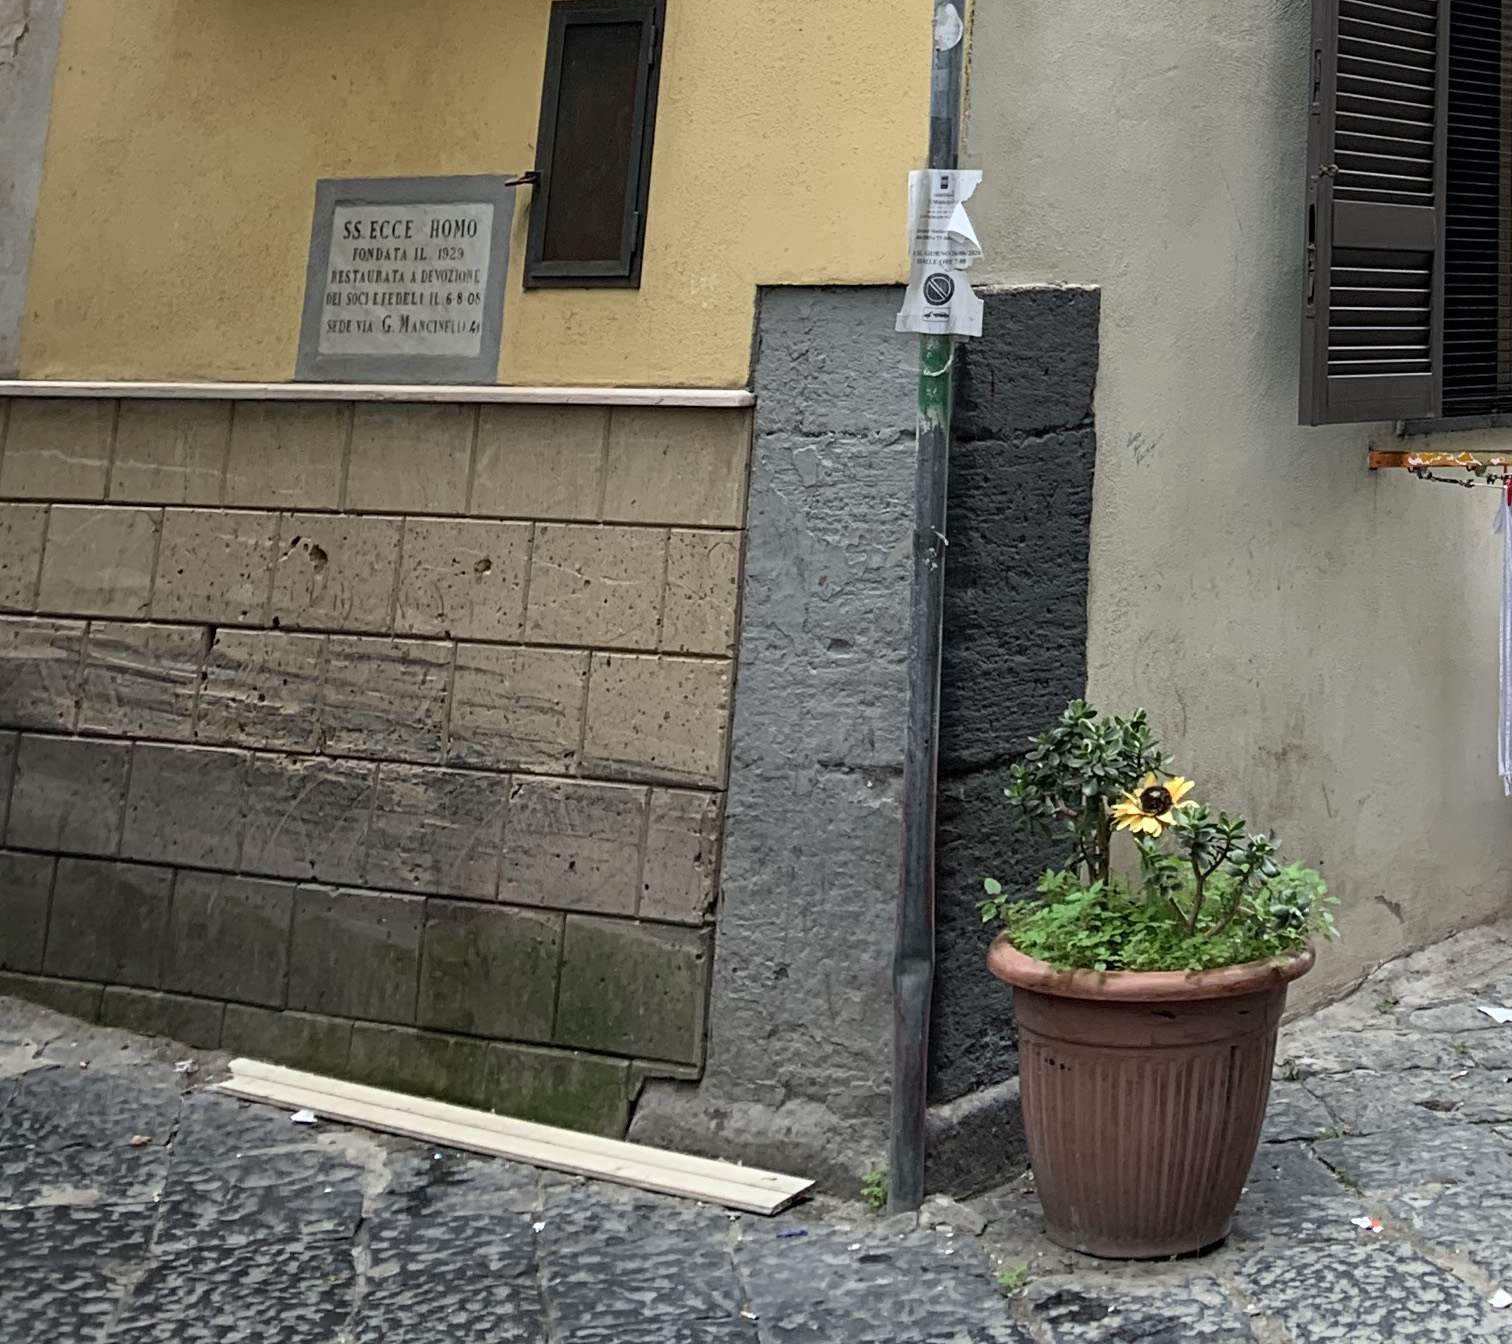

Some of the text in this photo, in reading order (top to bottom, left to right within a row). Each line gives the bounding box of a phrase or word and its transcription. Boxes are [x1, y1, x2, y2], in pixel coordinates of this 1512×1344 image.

[369, 220, 414, 240] ECCE
[429, 218, 478, 239] HOMO
[352, 246, 407, 262] FONDATA
[437, 246, 464, 261] 1929
[330, 268, 480, 284] RESTAURATA A DEVOZIONE
[326, 291, 342, 306] DEI
[346, 291, 369, 306] SOCI
[381, 291, 423, 306] FEDELI
[326, 319, 352, 334] SEDE
[356, 319, 373, 334] VIA
